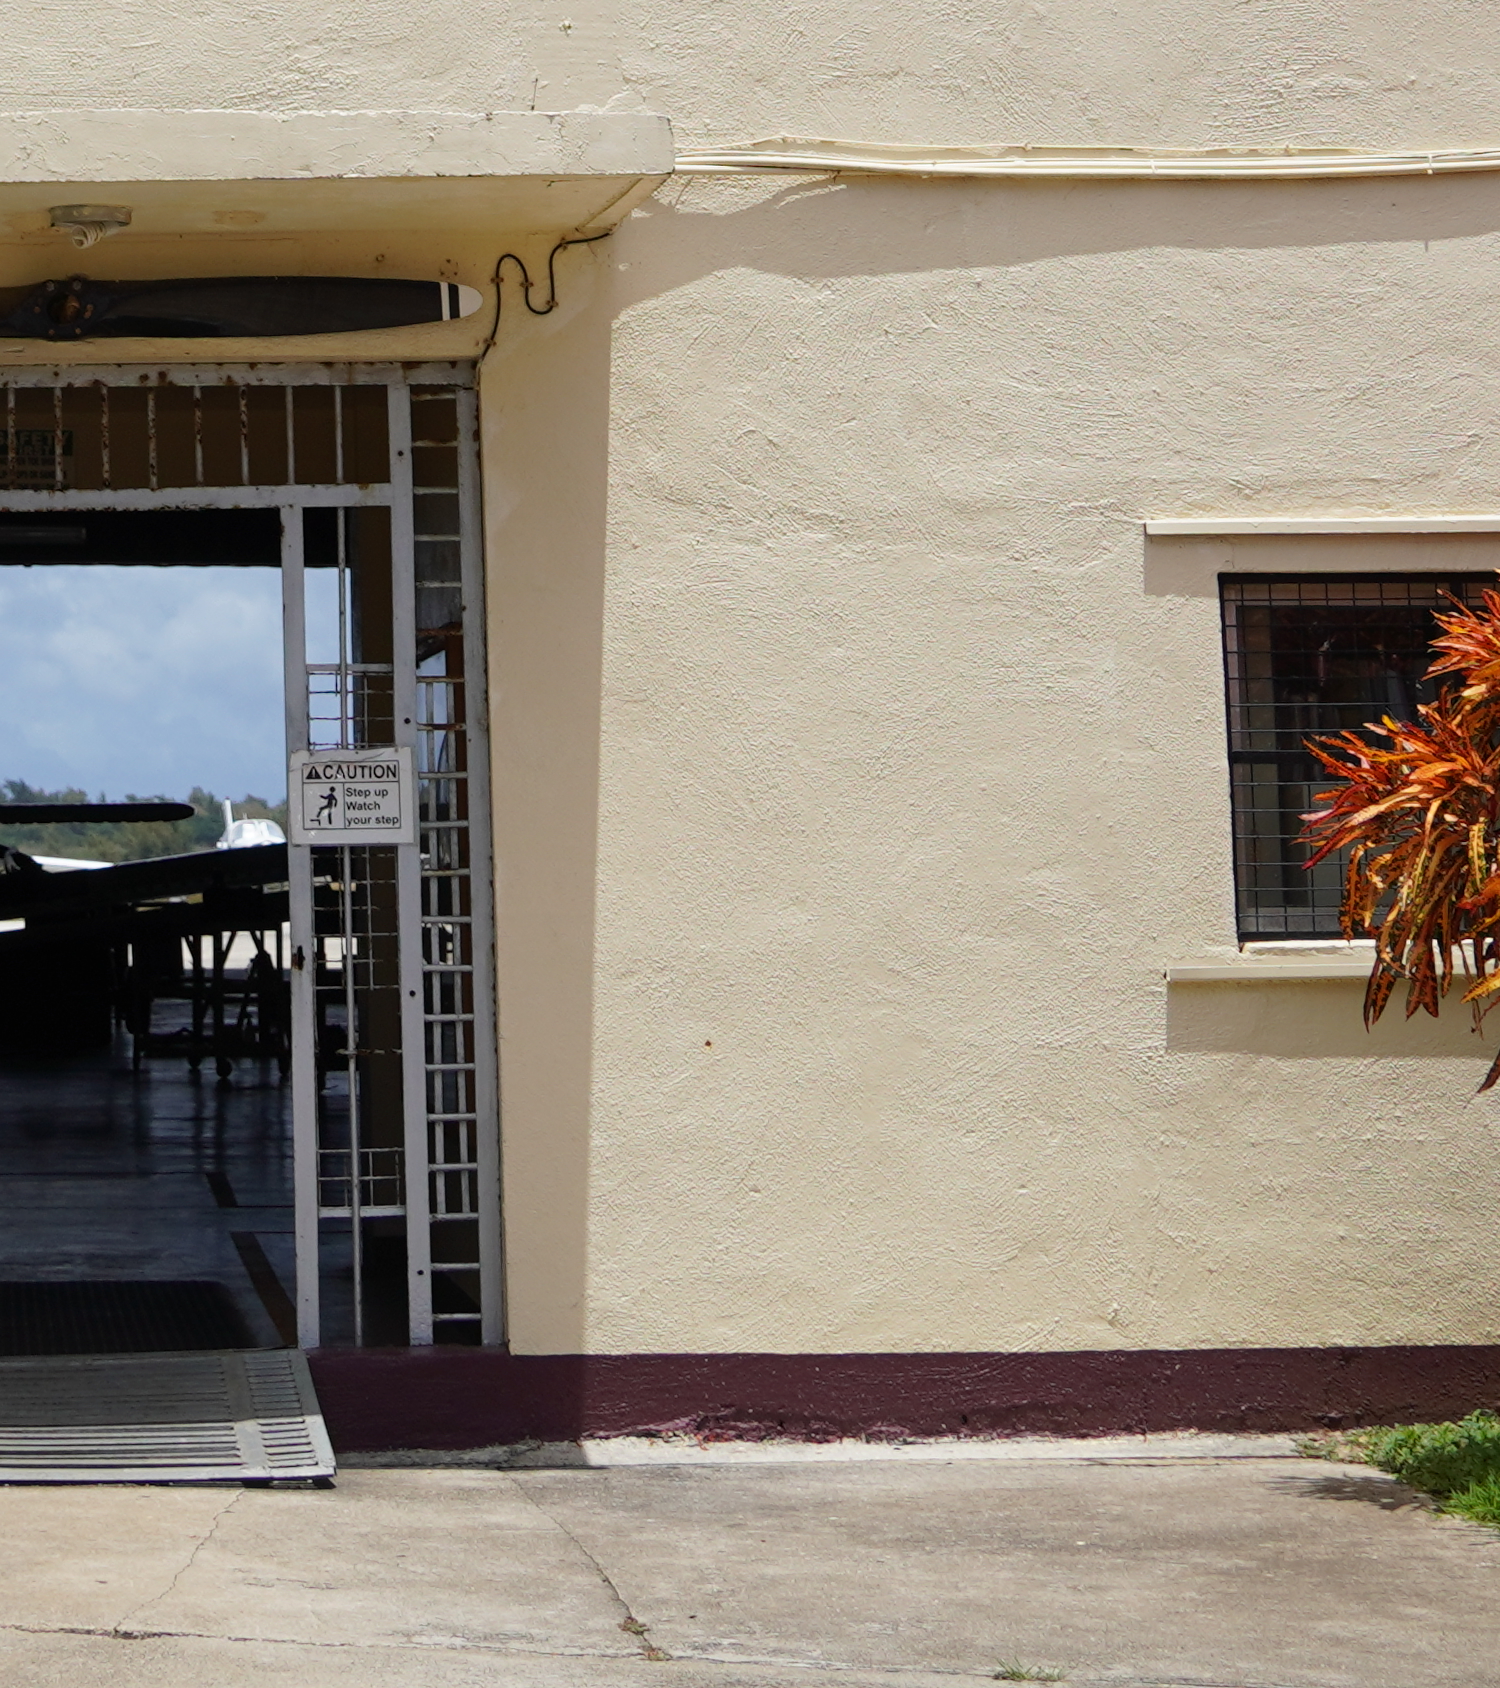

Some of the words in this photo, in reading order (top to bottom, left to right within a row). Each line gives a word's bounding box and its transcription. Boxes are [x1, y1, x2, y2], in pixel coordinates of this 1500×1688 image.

[323, 764, 397, 780] CAUTION
[345, 787, 371, 799] Step
[374, 789, 388, 799] up
[346, 801, 380, 811] Watch
[345, 817, 371, 827] your
[375, 816, 399, 826] step
